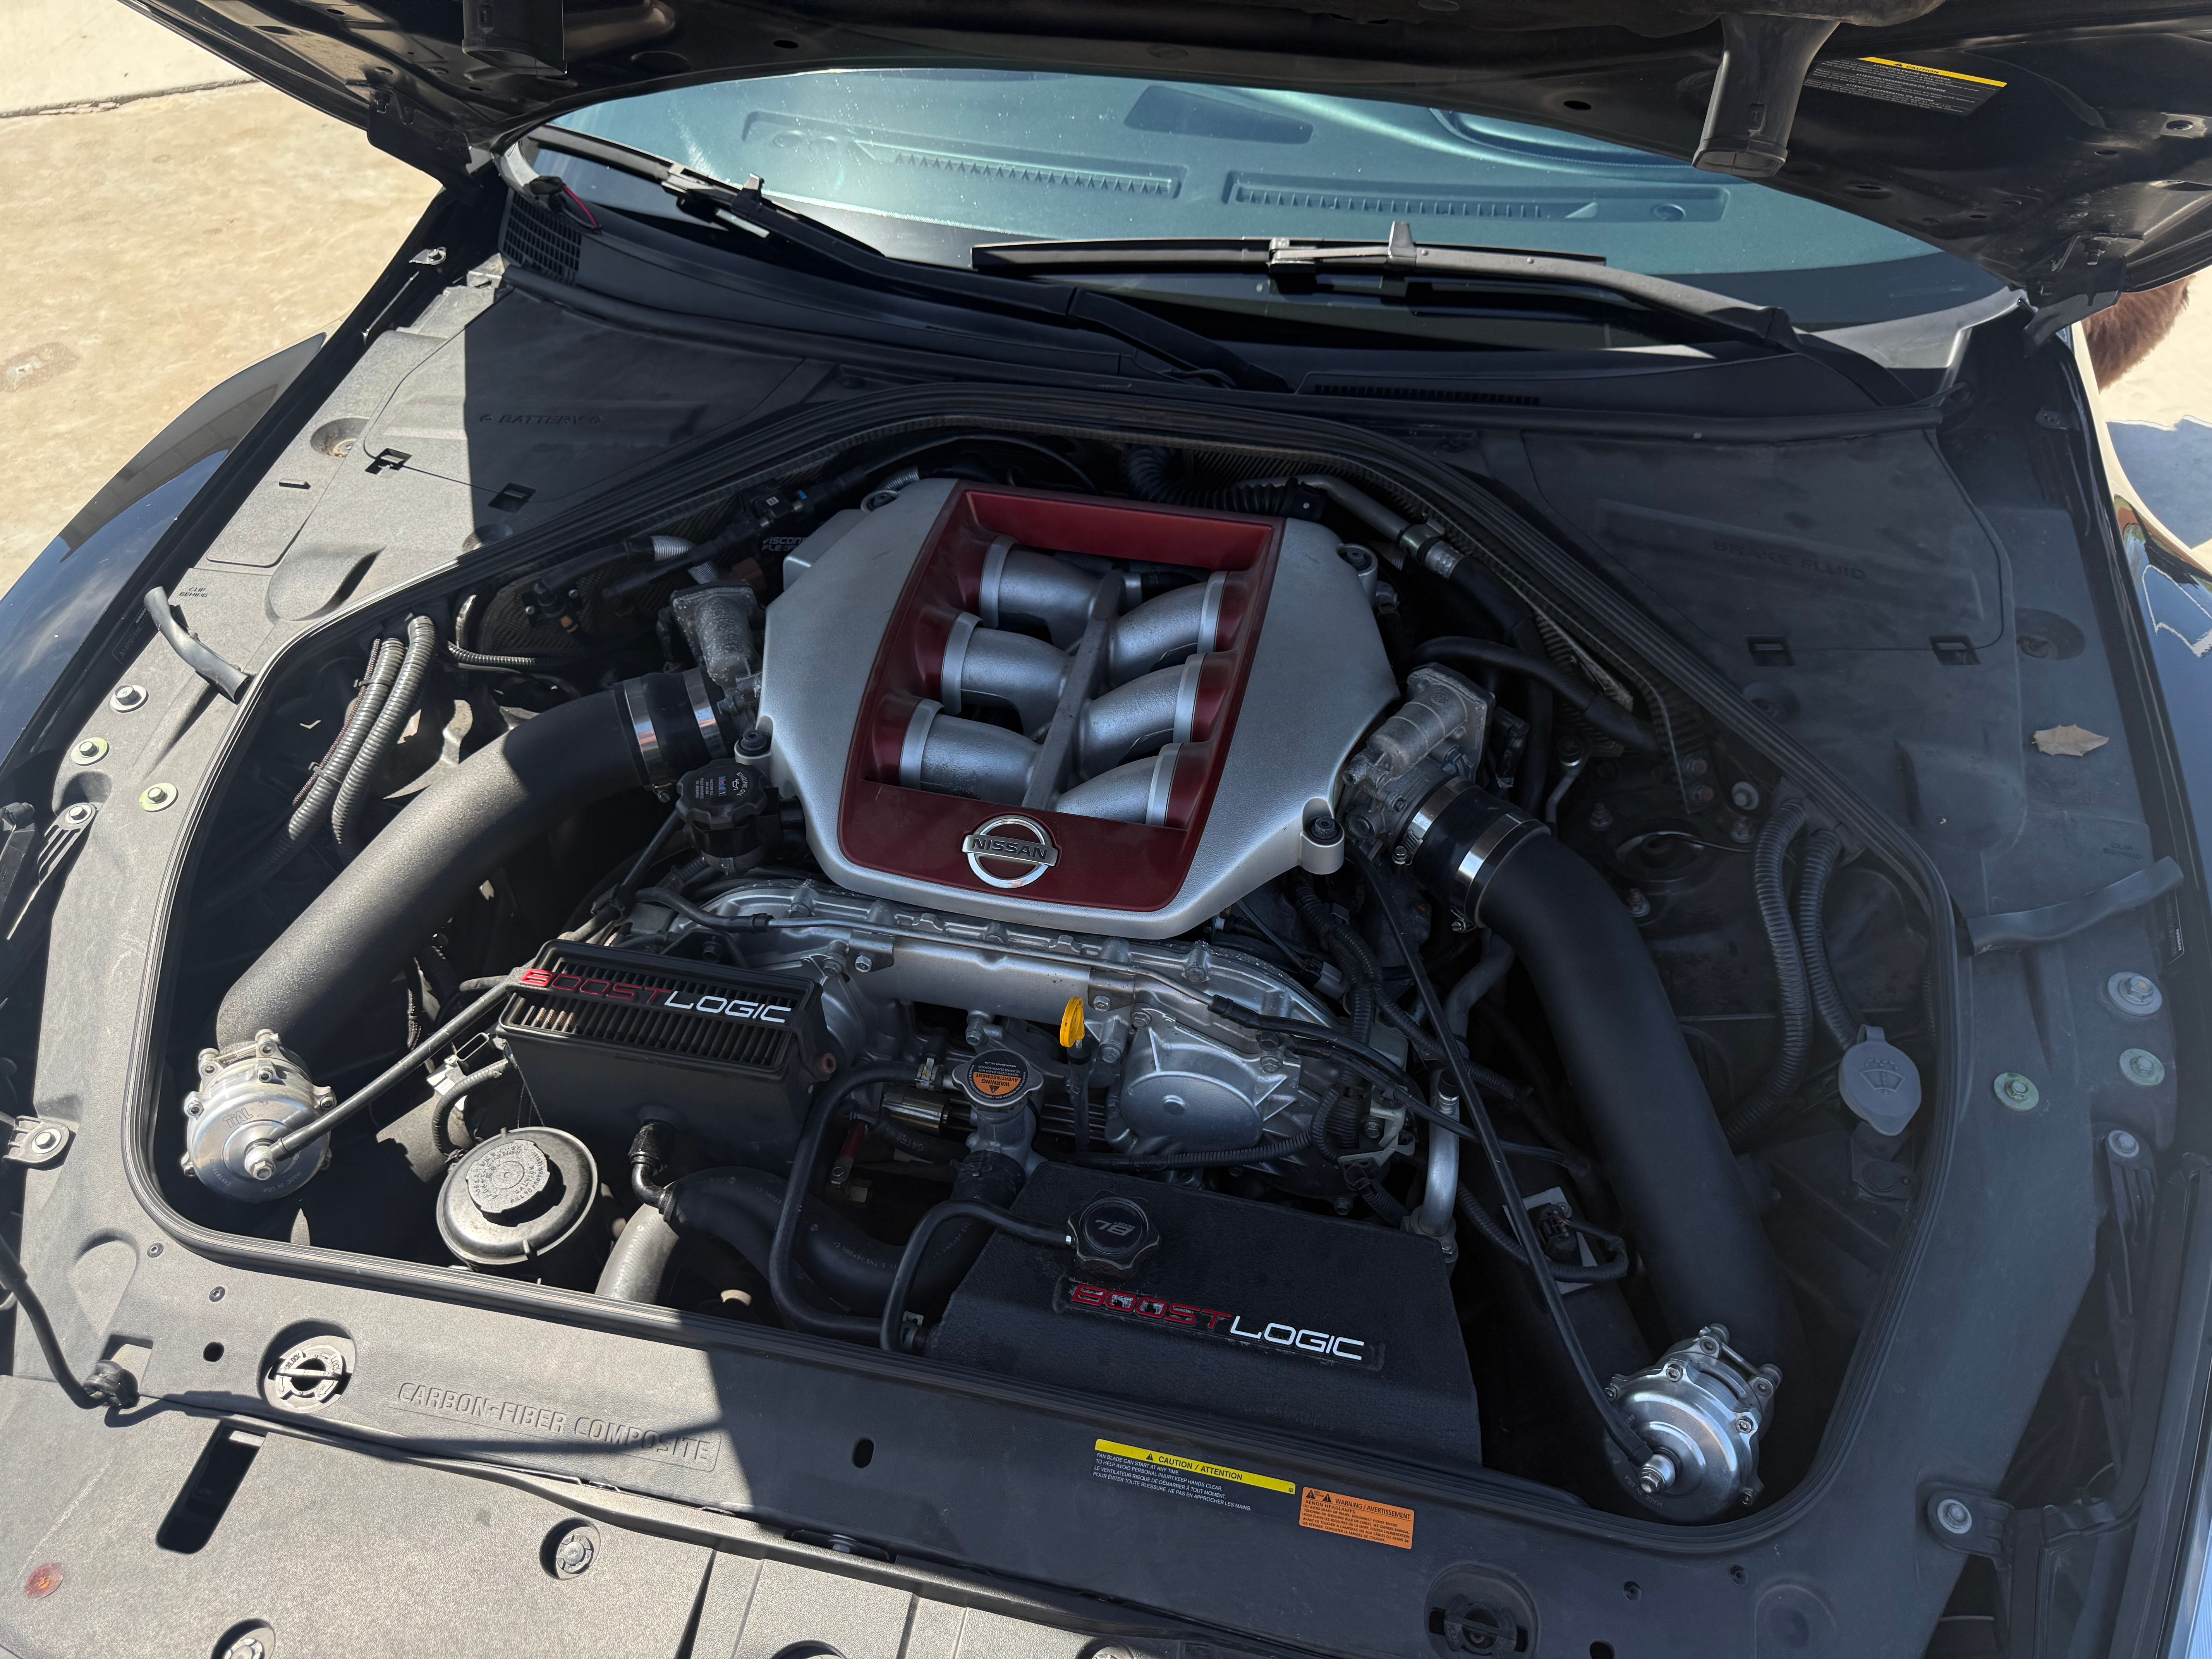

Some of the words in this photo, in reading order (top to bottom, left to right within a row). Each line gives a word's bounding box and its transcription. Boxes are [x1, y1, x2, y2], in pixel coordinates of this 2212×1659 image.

[1906, 65, 1939, 74] CAUTION
[498, 414, 586, 425] BATTERY
[1713, 539, 1791, 566] BRAKE
[1800, 558, 1867, 580] FLUID
[737, 772, 748, 788] ENGINE
[972, 838, 1047, 859] NISSAN
[975, 1073, 1018, 1082] AVERTISSEMENT
[223, 1108, 253, 1128] TiAL
[285, 1171, 302, 1186] MADE
[398, 1382, 567, 1434] CARBON-FIBER
[574, 1417, 713, 1461] COMPOSITE
[1132, 1467, 1157, 1476] PERSONAL
[1188, 1479, 1205, 1487] HANDS
[1159, 1456, 1193, 1469] CAUTION
[1200, 1466, 1242, 1480] ATTENTION
[1101, 1467, 1132, 1477] VENTILATEUR
[1132, 1474, 1150, 1482] RISQUE
[1159, 1479, 1185, 1489] DÉMARRER
[1204, 1490, 1226, 1499] MOMENT.
[1108, 1473, 1124, 1482] ÉVITER
[1194, 1494, 1224, 1505] APPROCHER
[1625, 1475, 1635, 1487] USA
[1325, 1503, 1356, 1514] HEADLAMPS
[1336, 1498, 1362, 1509] WARNING
[1367, 1505, 1411, 1519] AVERTISSEMENT
[1646, 1496, 1662, 1507] MADE
